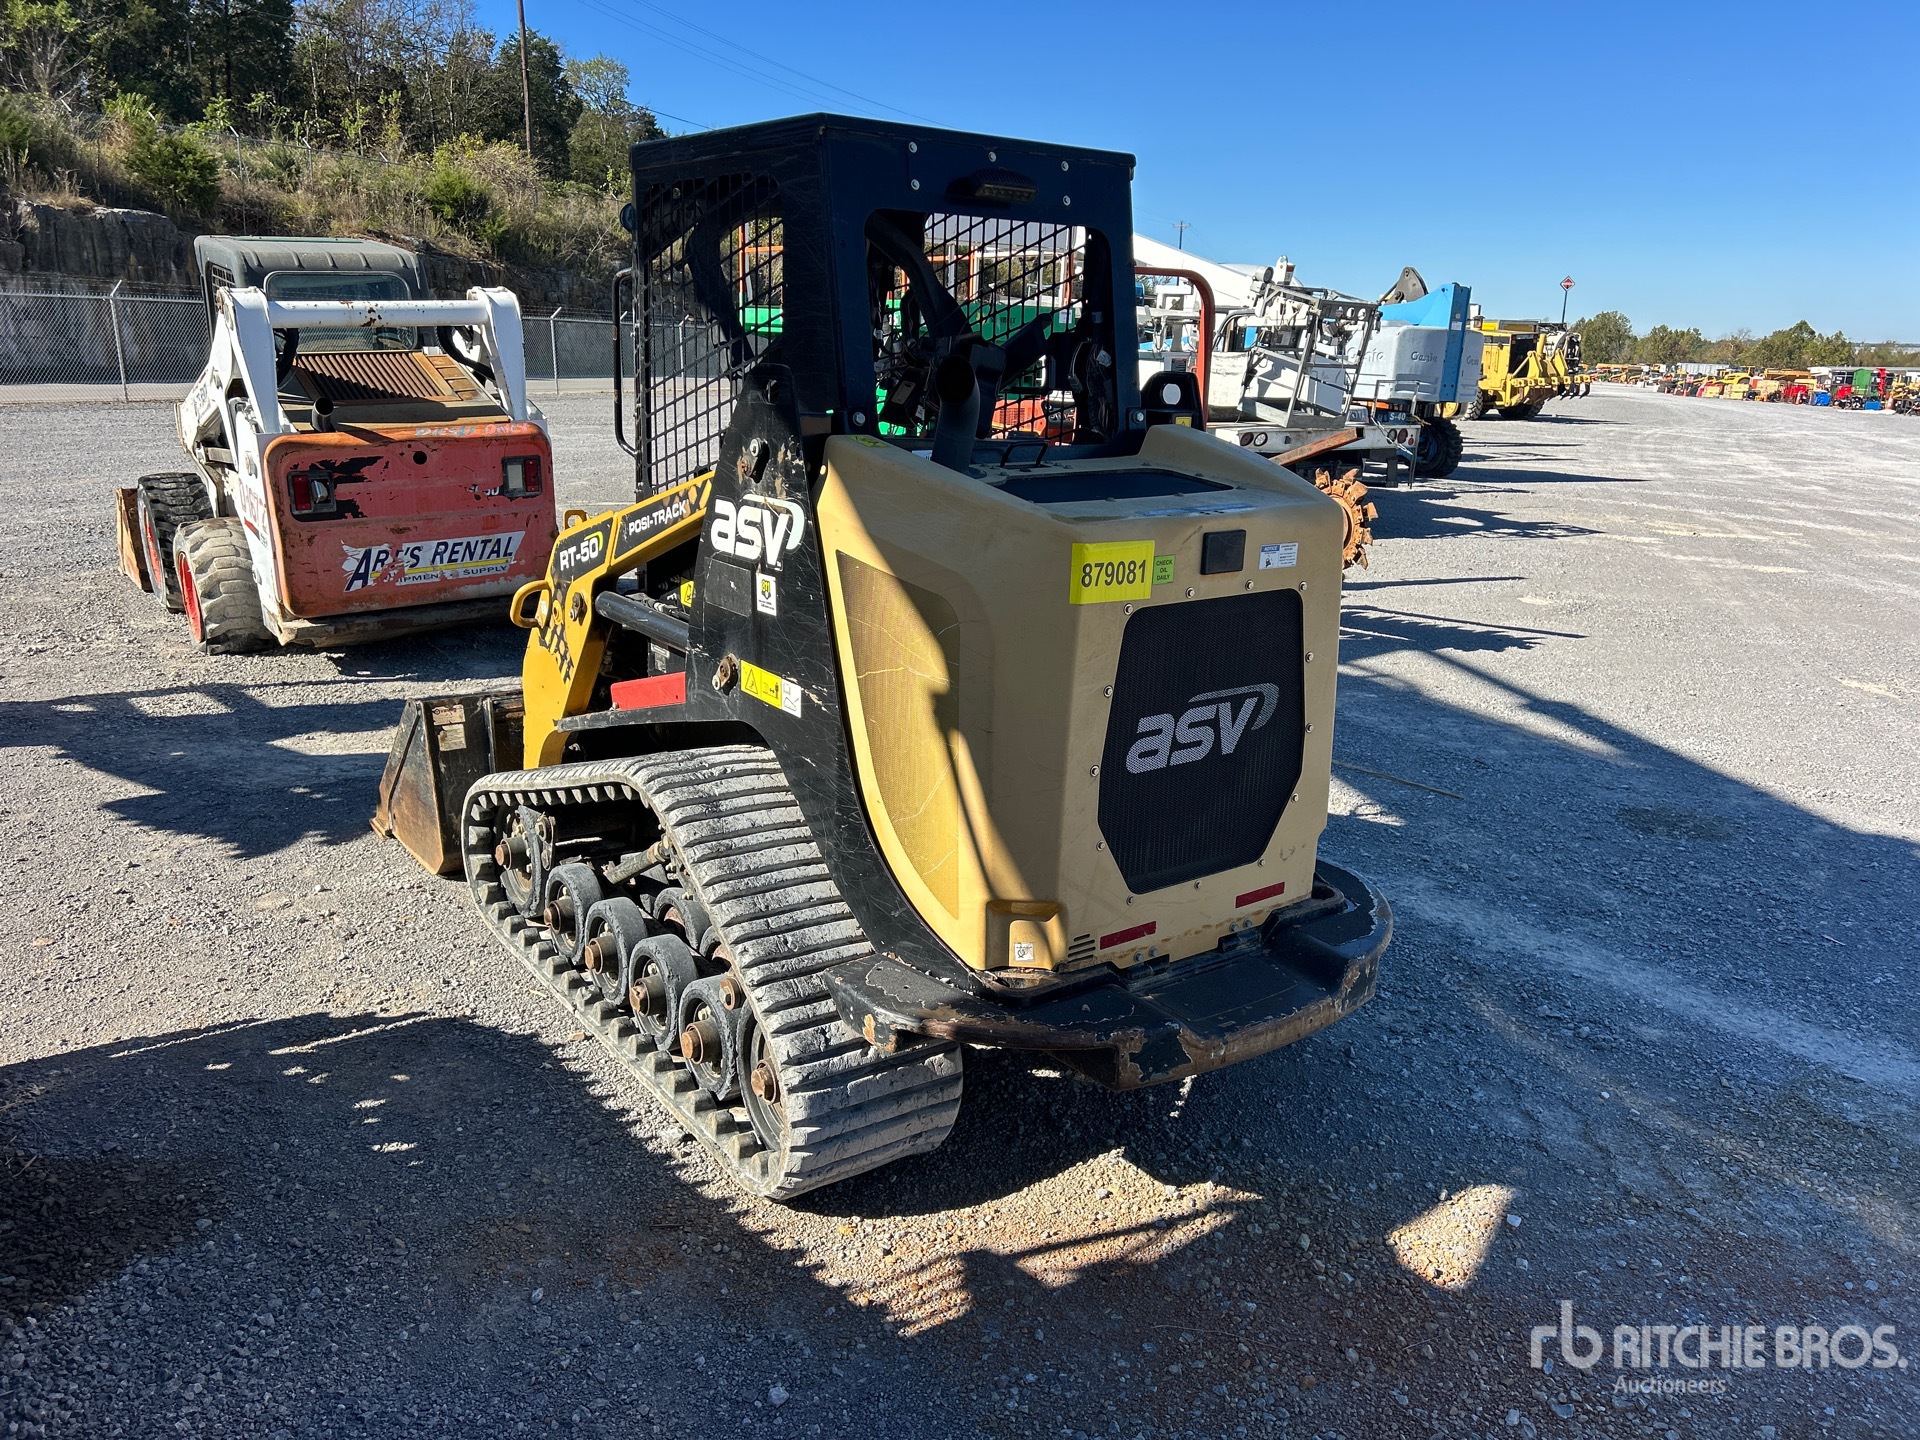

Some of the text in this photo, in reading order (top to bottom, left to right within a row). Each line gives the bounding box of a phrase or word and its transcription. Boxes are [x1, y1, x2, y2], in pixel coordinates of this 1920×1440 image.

[1347, 347, 1384, 362] Gnie
[1411, 351, 1438, 362] Genie
[1389, 412, 1406, 421] S-40
[628, 500, 688, 536] POSI-TRACK
[345, 536, 513, 591] AR'S RENTAL
[559, 537, 599, 571] RT-50
[463, 565, 508, 576] SUPPLY
[1081, 560, 1146, 588] 879081
